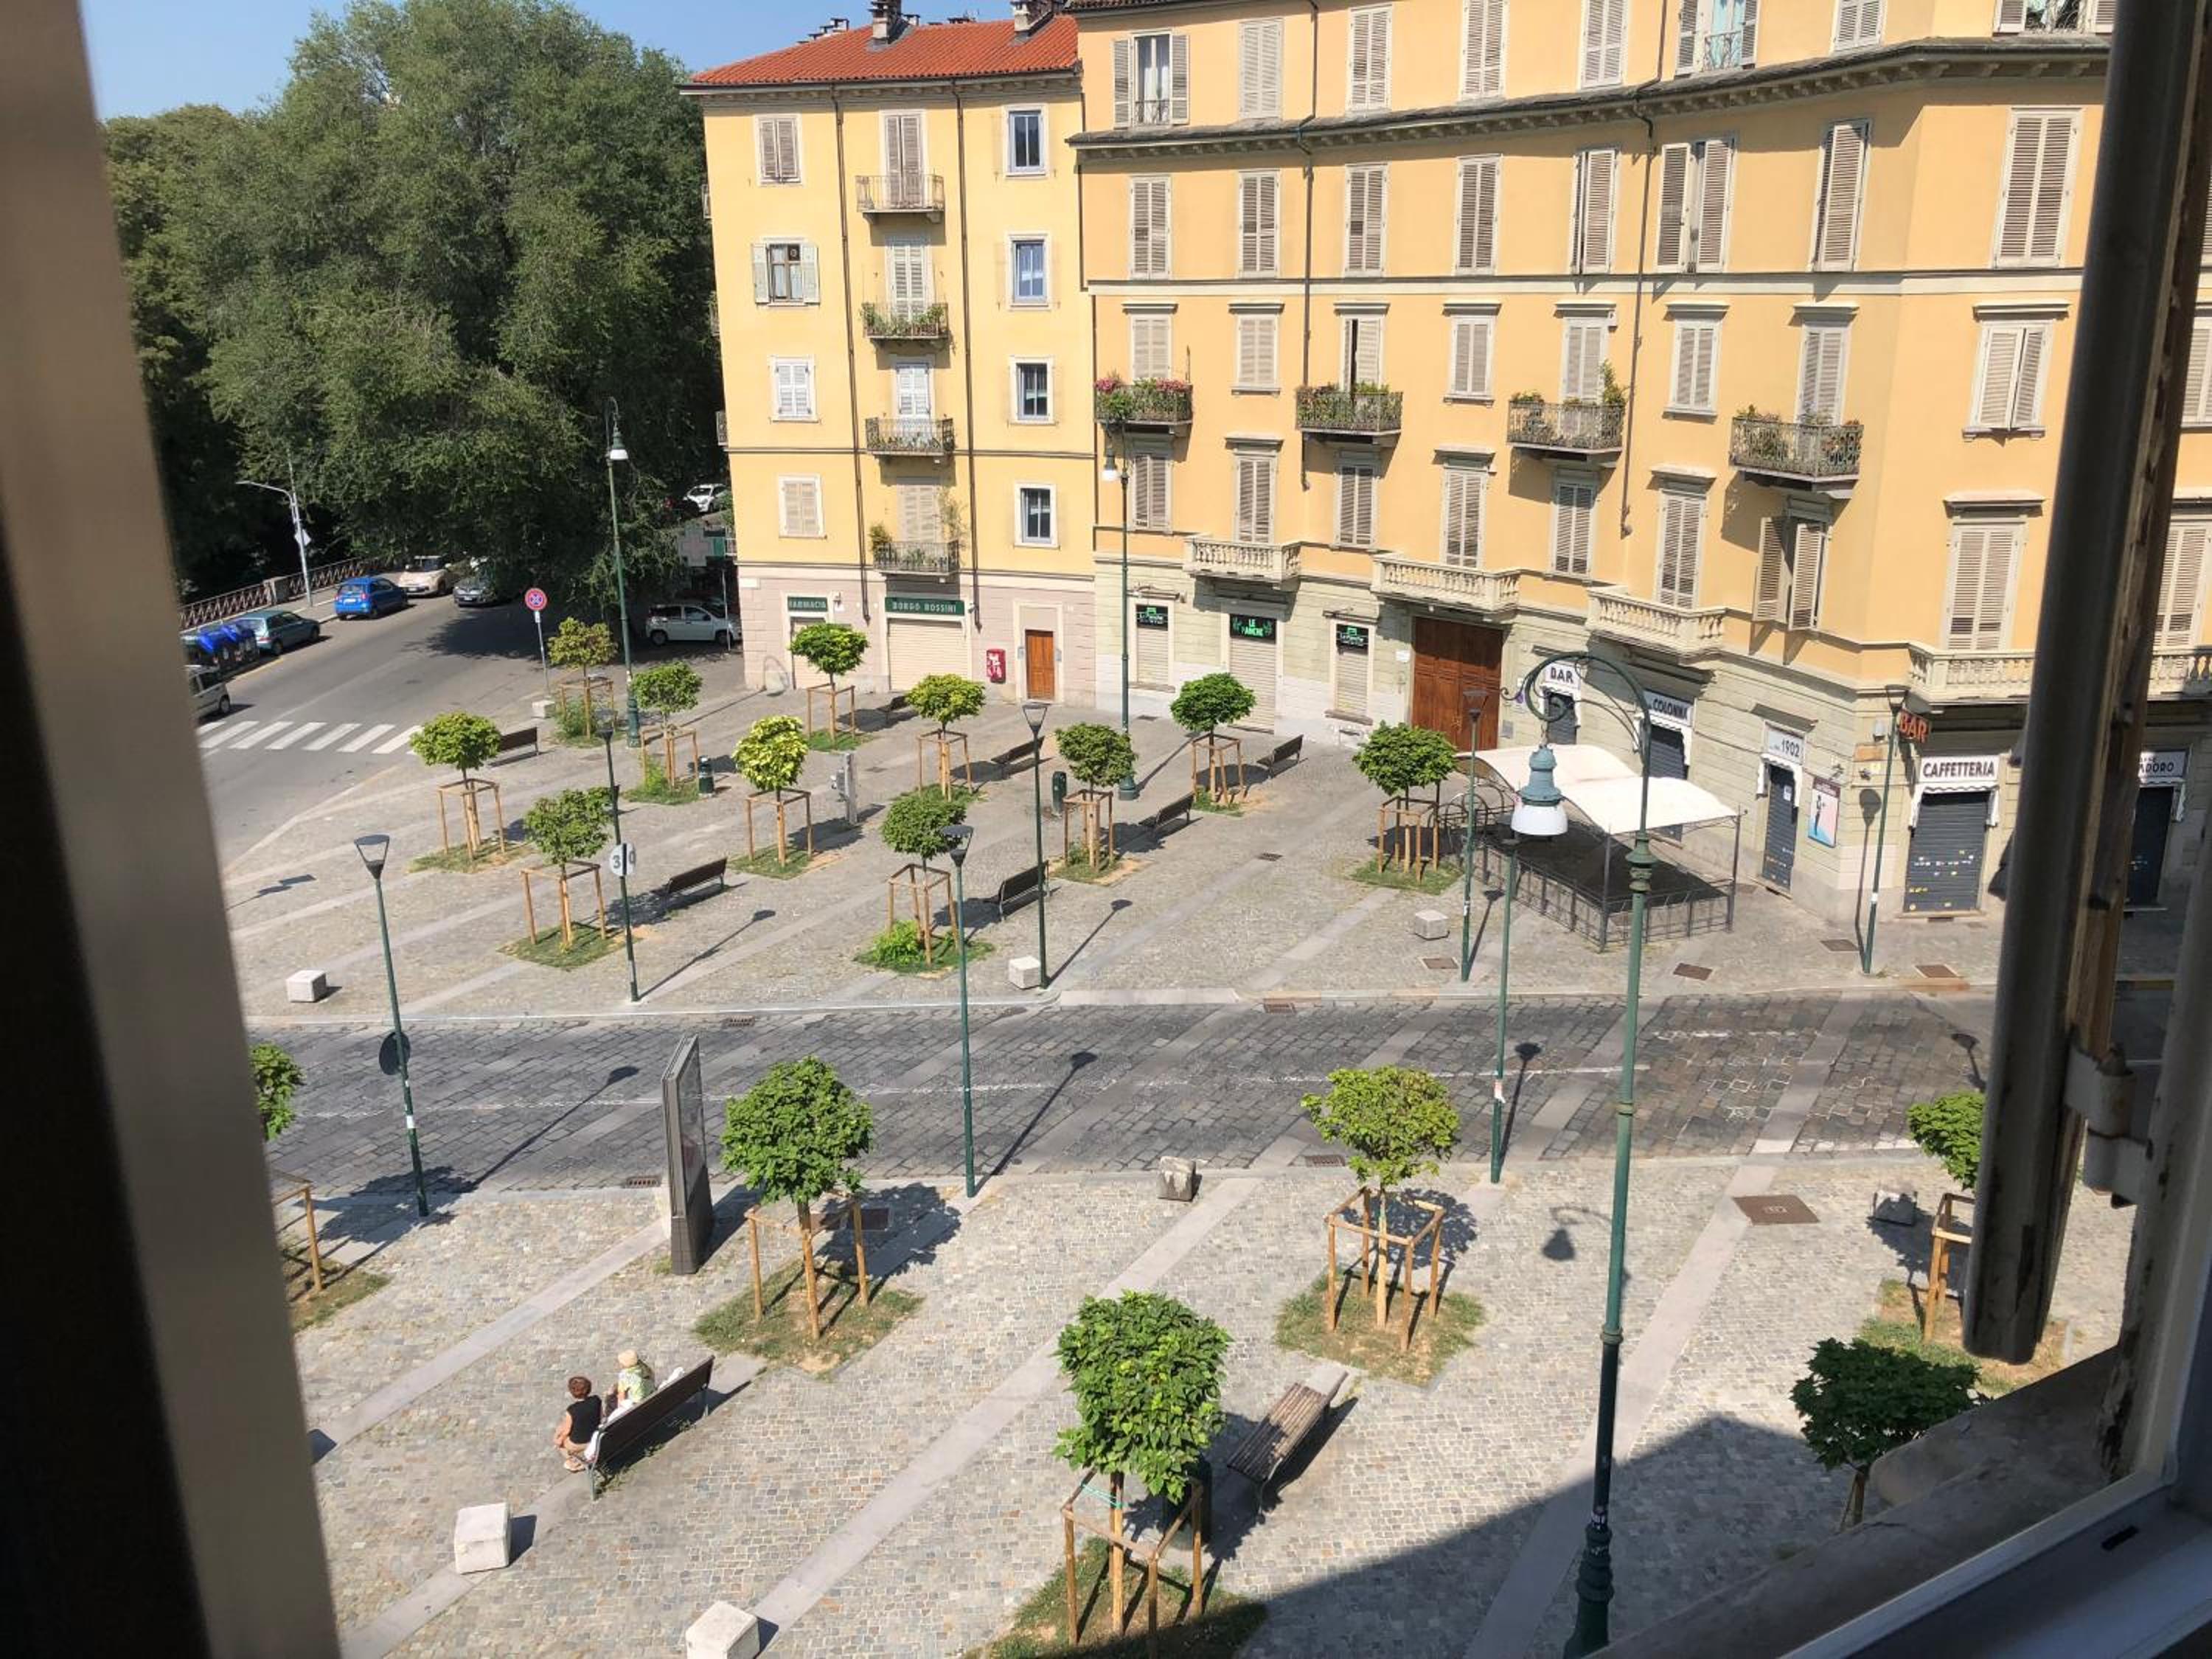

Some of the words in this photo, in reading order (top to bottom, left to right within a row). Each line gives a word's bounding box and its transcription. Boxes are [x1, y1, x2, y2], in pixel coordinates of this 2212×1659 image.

[892, 602, 920, 611] BORGO
[924, 603, 956, 613] ROSSINI
[1248, 619, 1256, 627] LE
[1551, 667, 1574, 684] BAR
[1899, 711, 1928, 744] BAR
[1781, 738, 1800, 757] 1902
[1922, 762, 1995, 778] CAFFETTERIA
